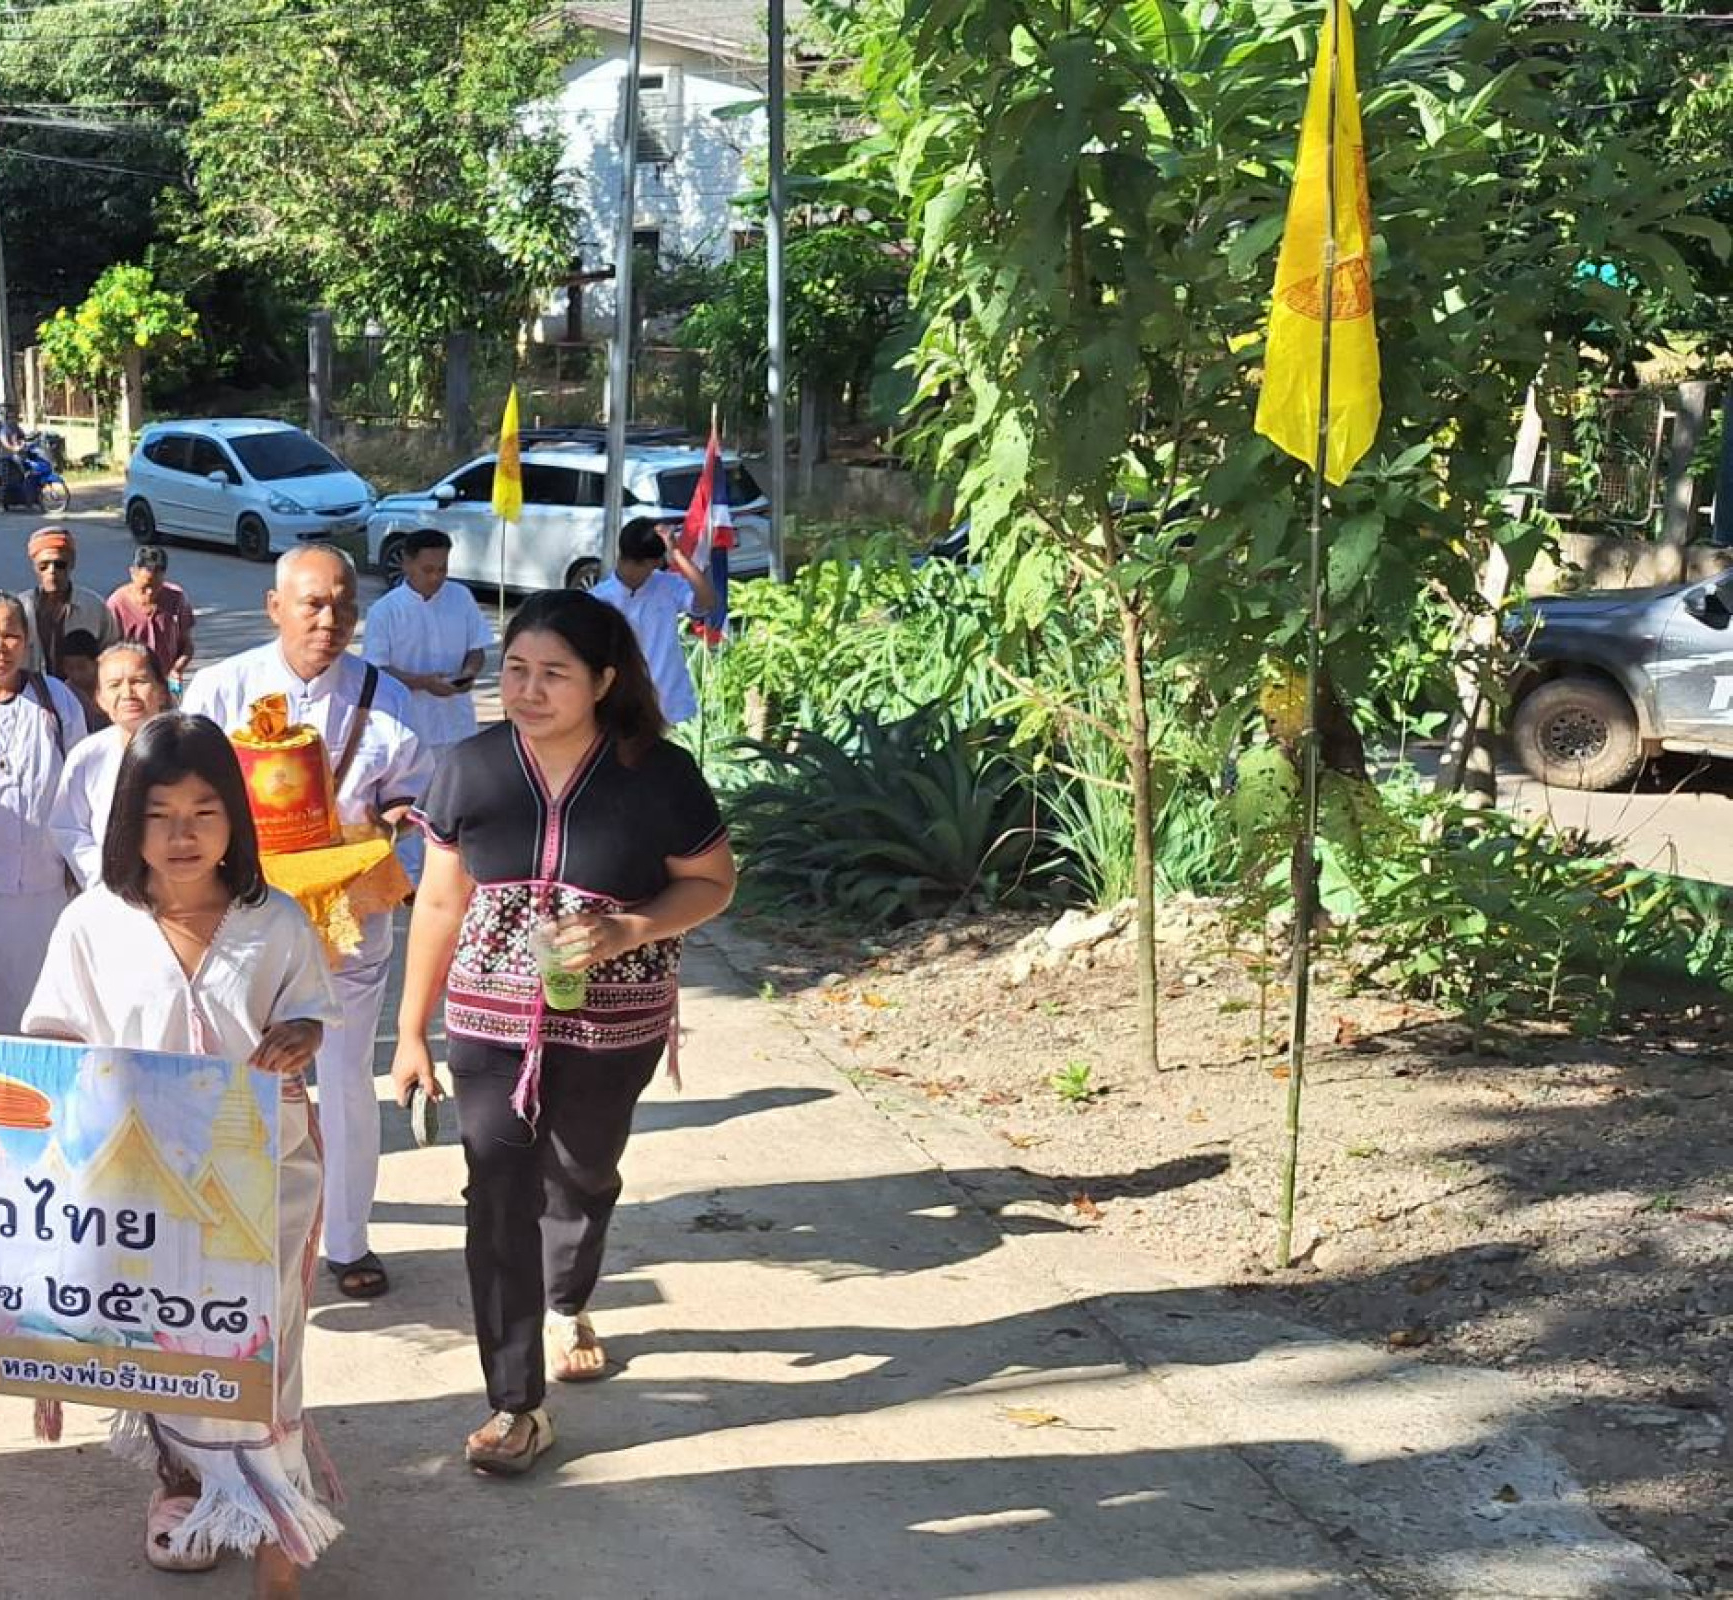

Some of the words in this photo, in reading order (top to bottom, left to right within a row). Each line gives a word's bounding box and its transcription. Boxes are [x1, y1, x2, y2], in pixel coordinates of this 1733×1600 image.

[45, 1275, 249, 1334] ๒๕๖๘
[1, 1356, 240, 1401] หลวงพ่อธัมมชโย
